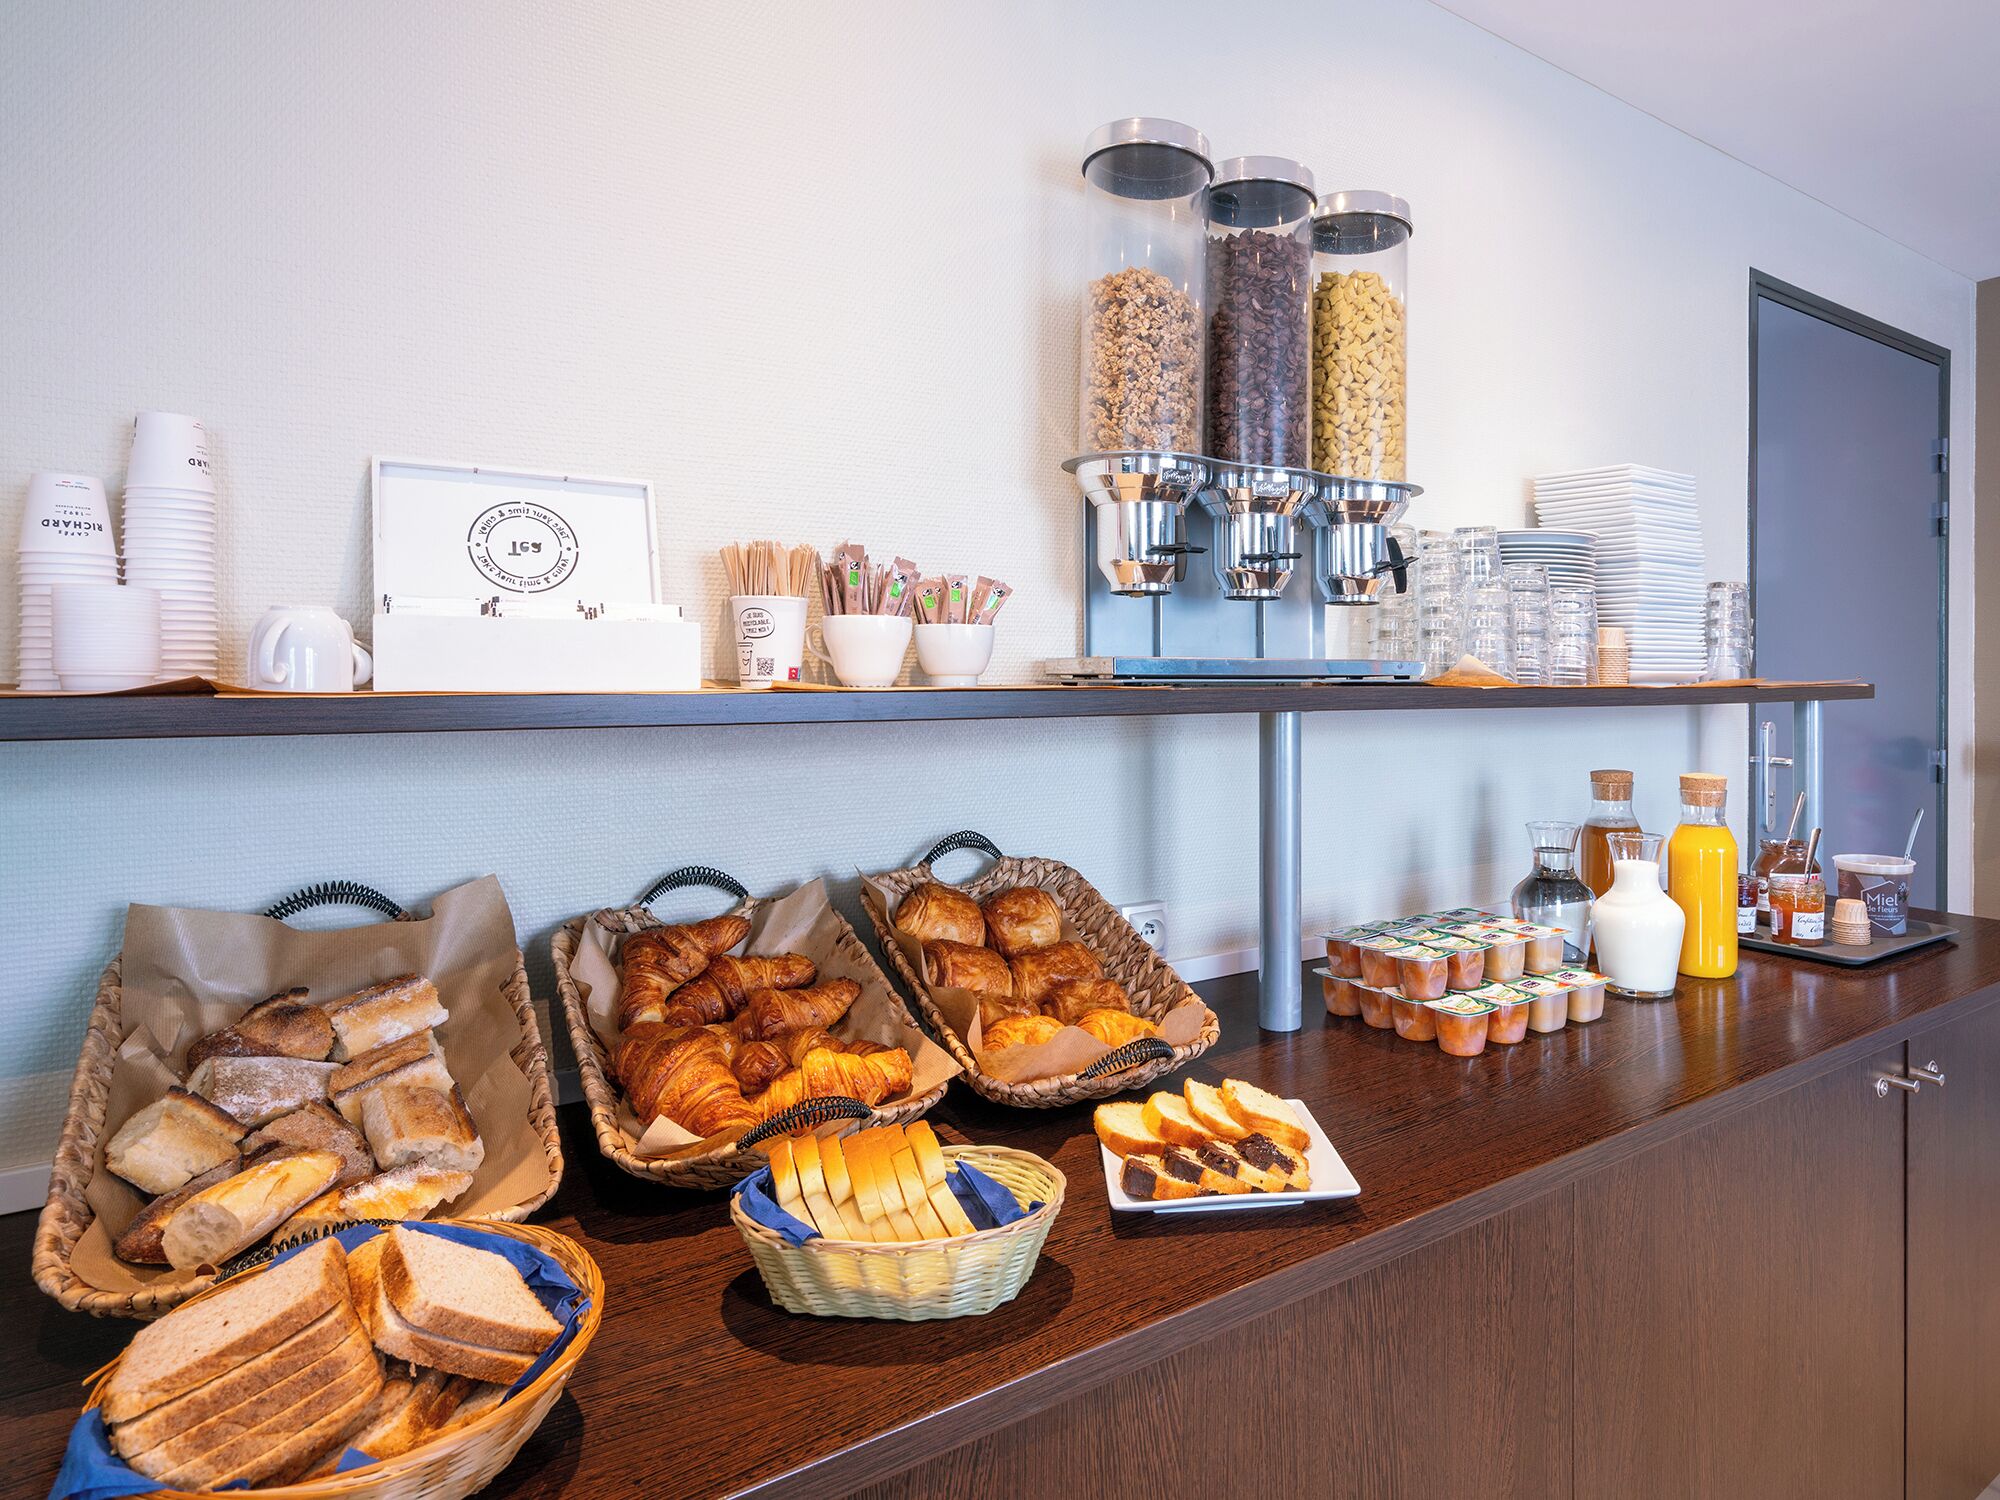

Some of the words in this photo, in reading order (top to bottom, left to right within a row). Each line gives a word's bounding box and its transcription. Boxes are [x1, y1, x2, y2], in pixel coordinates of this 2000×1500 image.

[41, 519, 103, 532] RICHARD
[1866, 892, 1899, 906] Miel
[1877, 905, 1899, 913] fleurs
